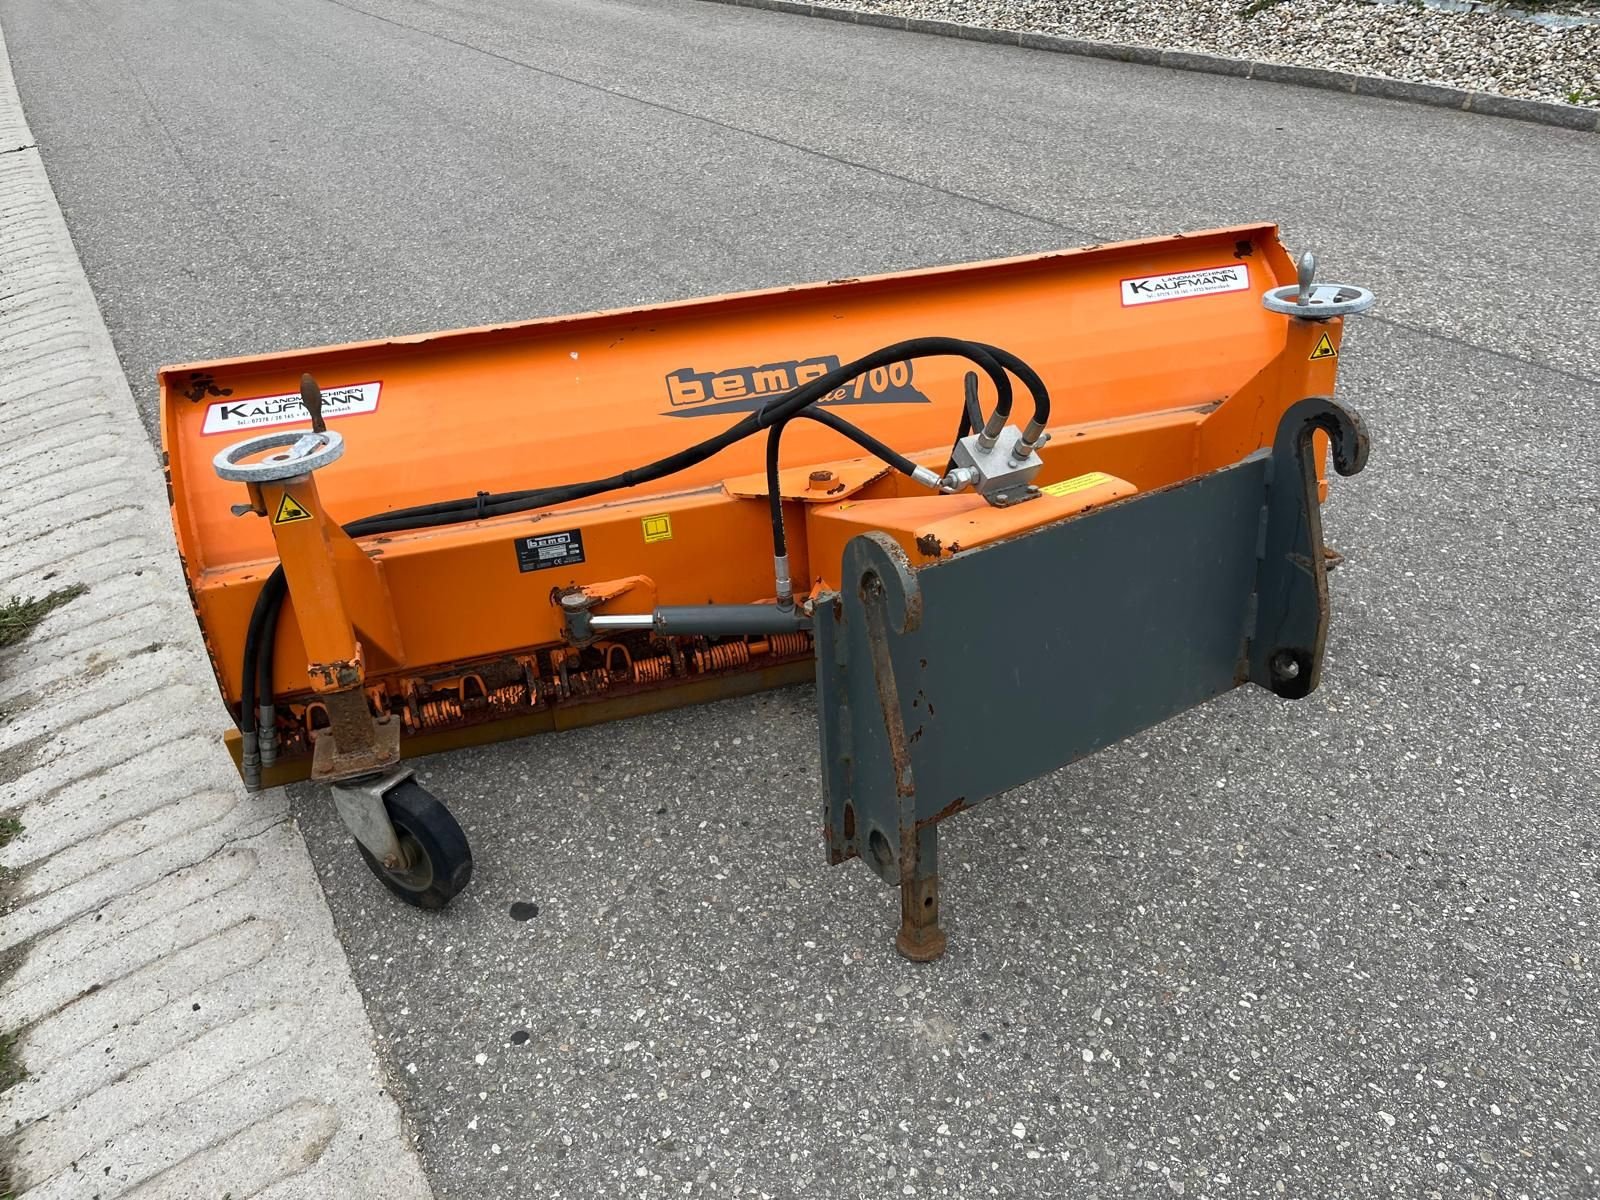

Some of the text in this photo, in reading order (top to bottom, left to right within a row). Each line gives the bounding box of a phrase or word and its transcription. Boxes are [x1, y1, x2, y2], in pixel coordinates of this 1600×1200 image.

[1130, 273, 1238, 294] KAUFMANN
[1161, 269, 1235, 282] LANDMASCHINEN
[667, 361, 829, 406] bema
